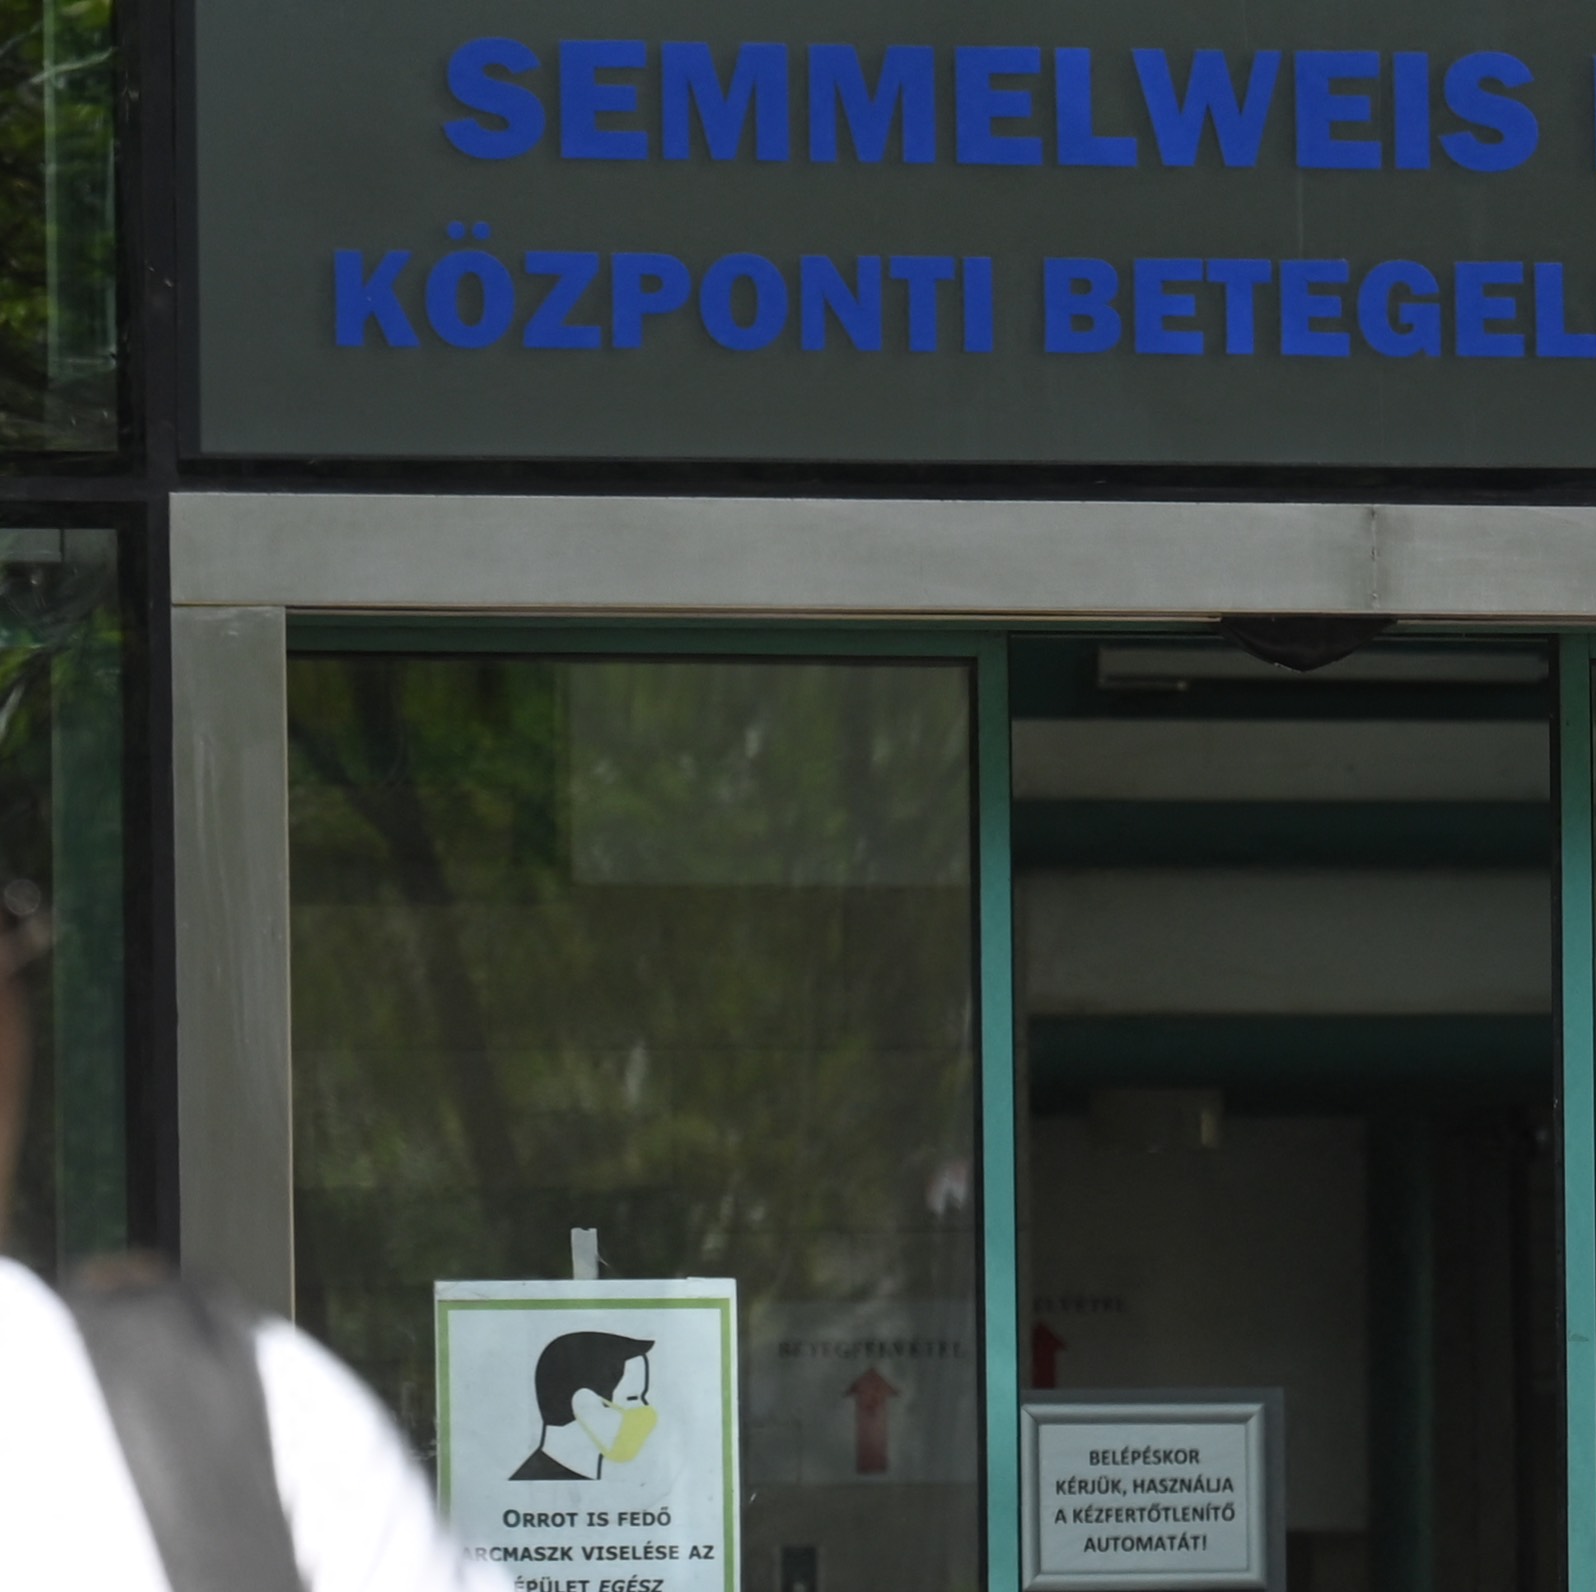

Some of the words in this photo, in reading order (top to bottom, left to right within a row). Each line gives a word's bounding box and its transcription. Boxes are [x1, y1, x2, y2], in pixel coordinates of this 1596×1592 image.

[445, 38, 1539, 173] SEMMELWEIS
[335, 222, 994, 353] KÖZPONTI
[1089, 1446, 1200, 1466] BELÉPÉSKOR
[1055, 1475, 1128, 1497] KÉRJÜK,
[1132, 1473, 1235, 1494] HASZNÁLJA
[502, 1508, 579, 1528] ORROT
[586, 1511, 610, 1528] IS
[617, 1506, 672, 1527] FEDŐ
[1054, 1508, 1068, 1525] A
[1072, 1503, 1236, 1524] KÉZFERTŐTLENÍTŐ
[581, 1540, 680, 1561] VISELÉSE
[688, 1544, 715, 1560] AZ
[1083, 1532, 1207, 1553] AUTOMATÁT!
